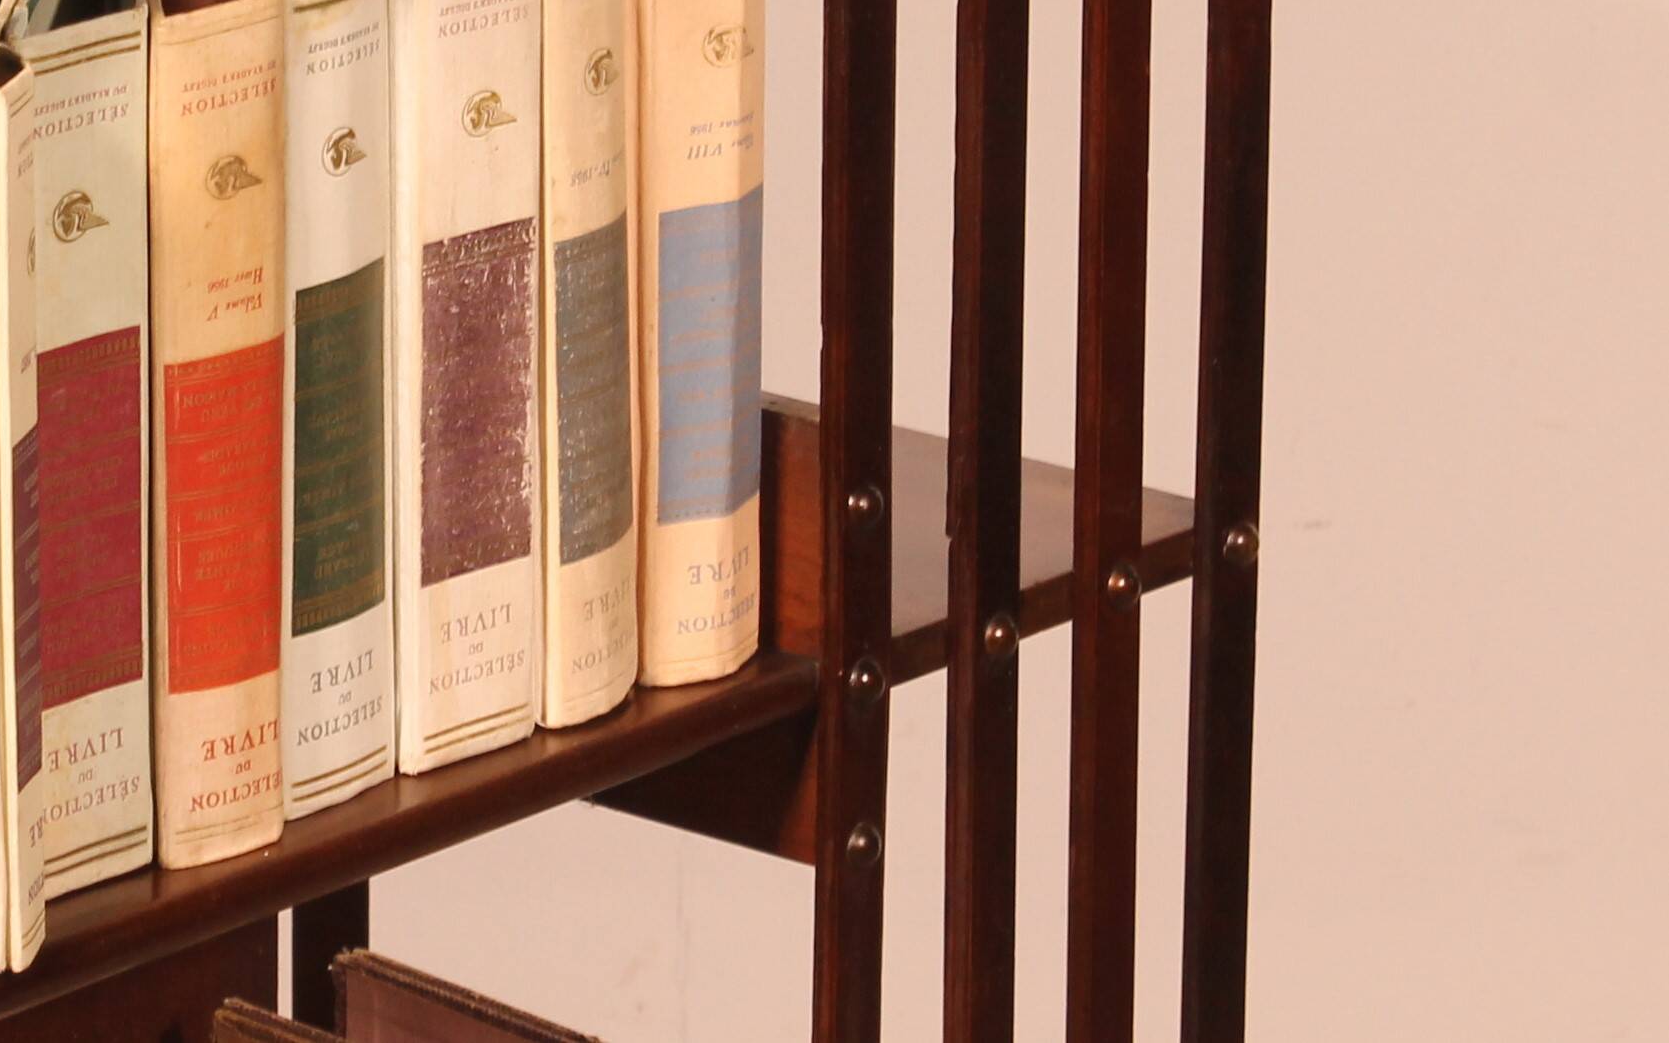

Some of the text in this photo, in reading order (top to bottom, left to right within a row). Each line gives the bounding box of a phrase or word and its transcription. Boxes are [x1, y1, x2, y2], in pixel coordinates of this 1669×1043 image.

[305, 38, 380, 76] SÉLECTION
[180, 76, 277, 117] SÉLECTION
[31, 103, 129, 140] SÉLECTION
[206, 292, 263, 322] Volume V
[687, 545, 750, 585] LIVRE
[439, 602, 512, 644] LIVRE
[469, 642, 484, 655] DU
[309, 648, 373, 694] LIVRE
[428, 649, 524, 694] SÉLECTION
[338, 690, 353, 705] DU
[200, 717, 279, 762] LIVRE
[296, 695, 383, 746] SÉLECTION
[47, 727, 123, 773] LIVRE
[235, 759, 251, 775] DU
[77, 768, 93, 784] DU
